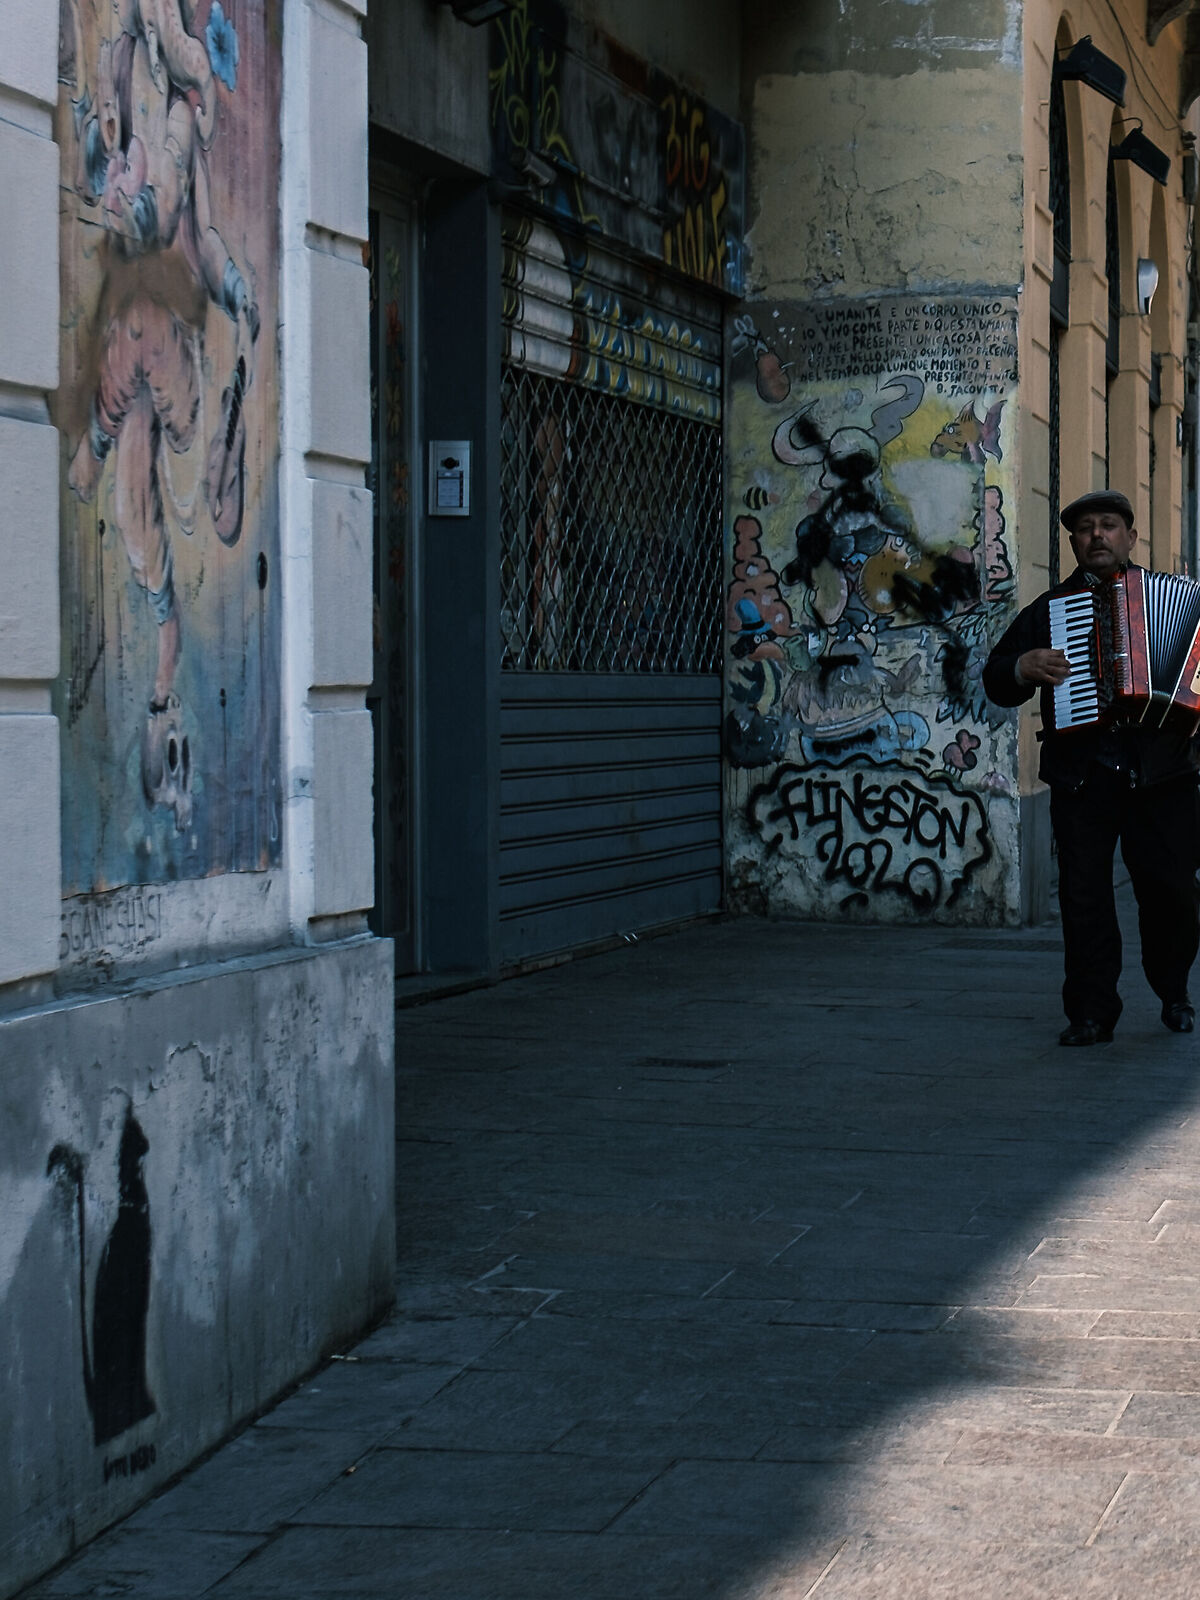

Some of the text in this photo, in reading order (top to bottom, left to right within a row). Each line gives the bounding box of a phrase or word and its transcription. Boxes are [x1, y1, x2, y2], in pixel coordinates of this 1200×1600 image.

[904, 305, 919, 316] UN
[921, 303, 958, 317] CORPO
[803, 328, 816, 340] IO
[852, 321, 882, 335] COME
[887, 319, 920, 334] PARTE
[934, 317, 976, 332] QUESTA
[829, 341, 849, 354] NEL
[852, 334, 904, 351] PRESENTE
[951, 331, 981, 344] COSA
[850, 350, 882, 364] NELLO
[883, 349, 918, 363] SPAZIO
[942, 345, 973, 358] PUNTO
[800, 370, 822, 382] NEL
[824, 366, 860, 380] TEMPO
[862, 360, 928, 375] QUALUNQUE
[931, 357, 979, 371] MOMENTO
